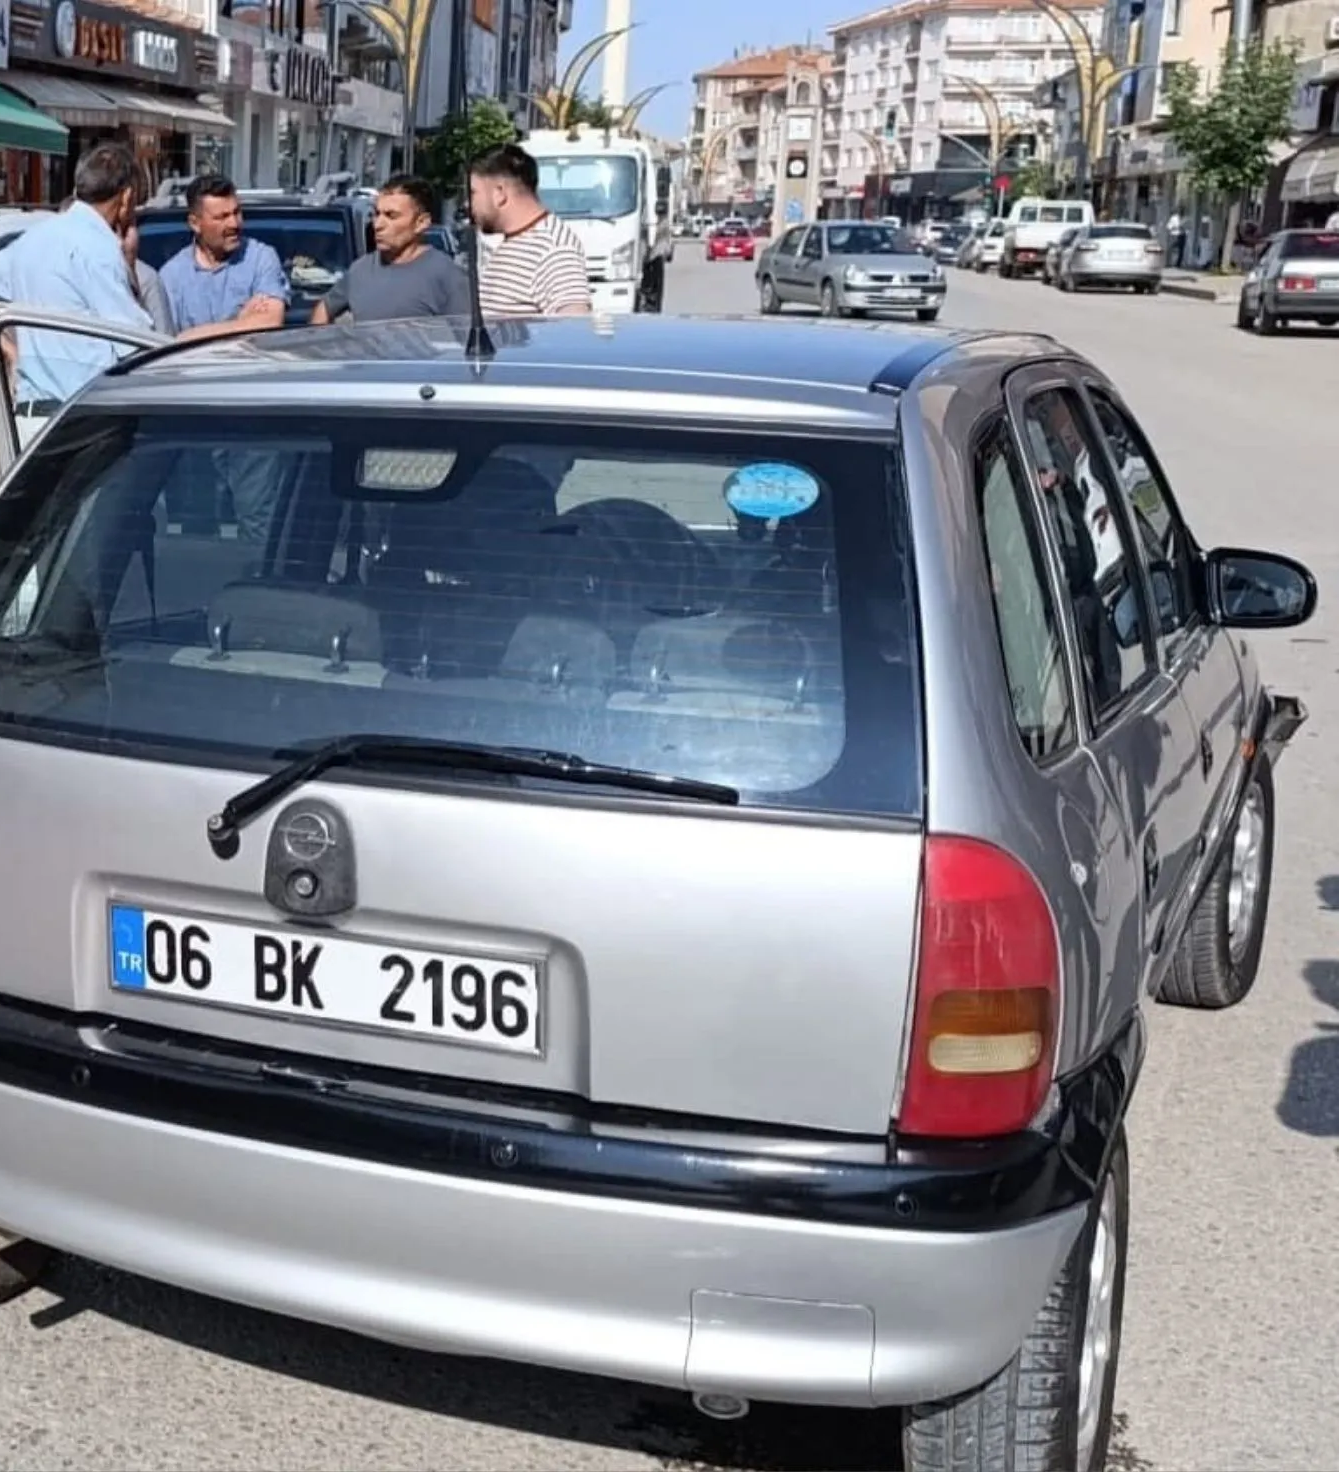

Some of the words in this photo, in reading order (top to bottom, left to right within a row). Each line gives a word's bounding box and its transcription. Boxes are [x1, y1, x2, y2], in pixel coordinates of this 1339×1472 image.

[118, 952, 143, 973] TR
[145, 919, 212, 990] 06
[254, 935, 324, 1010] BK
[380, 954, 529, 1037] 2196
